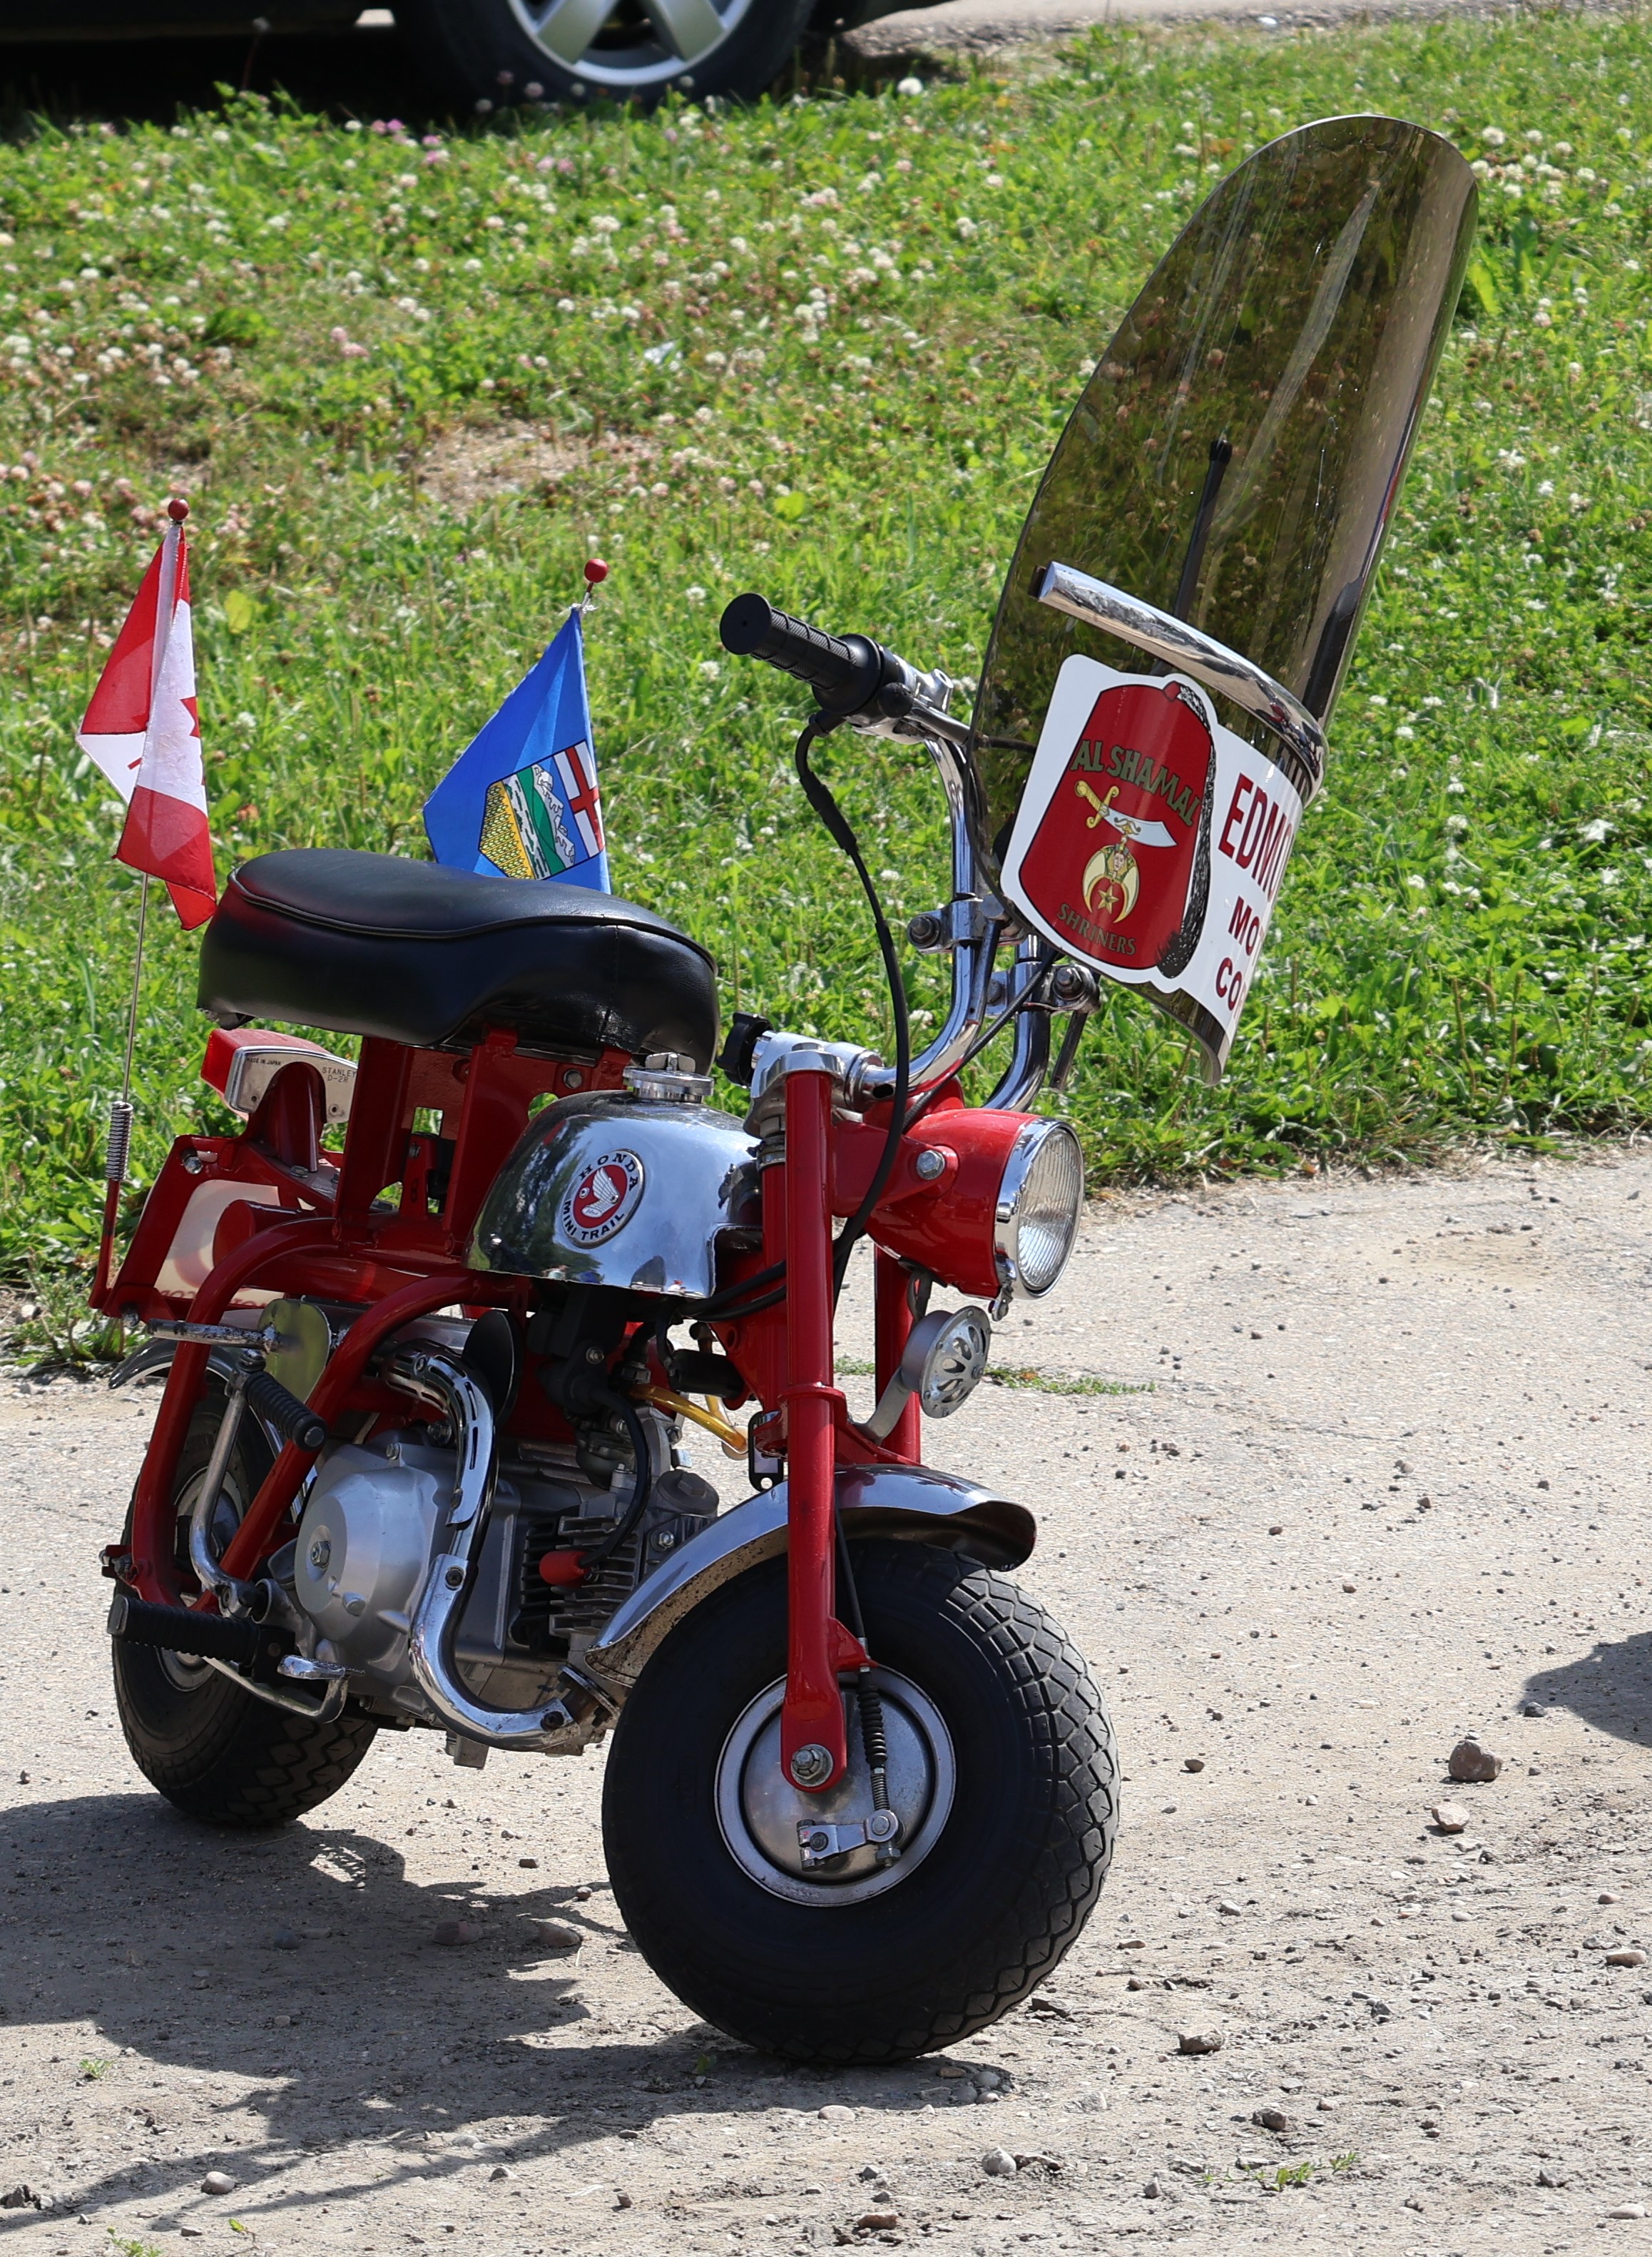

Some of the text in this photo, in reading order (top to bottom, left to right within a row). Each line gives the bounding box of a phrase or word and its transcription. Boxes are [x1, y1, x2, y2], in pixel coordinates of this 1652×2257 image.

[1070, 739, 1201, 827] AL SHAMAL
[1218, 773, 1295, 902] EDMO
[1056, 903, 1137, 956] SHRINERS
[322, 1066, 356, 1078] STANLEY
[578, 1153, 639, 1191] HONDA
[562, 1200, 625, 1240] MINI TRAIL
